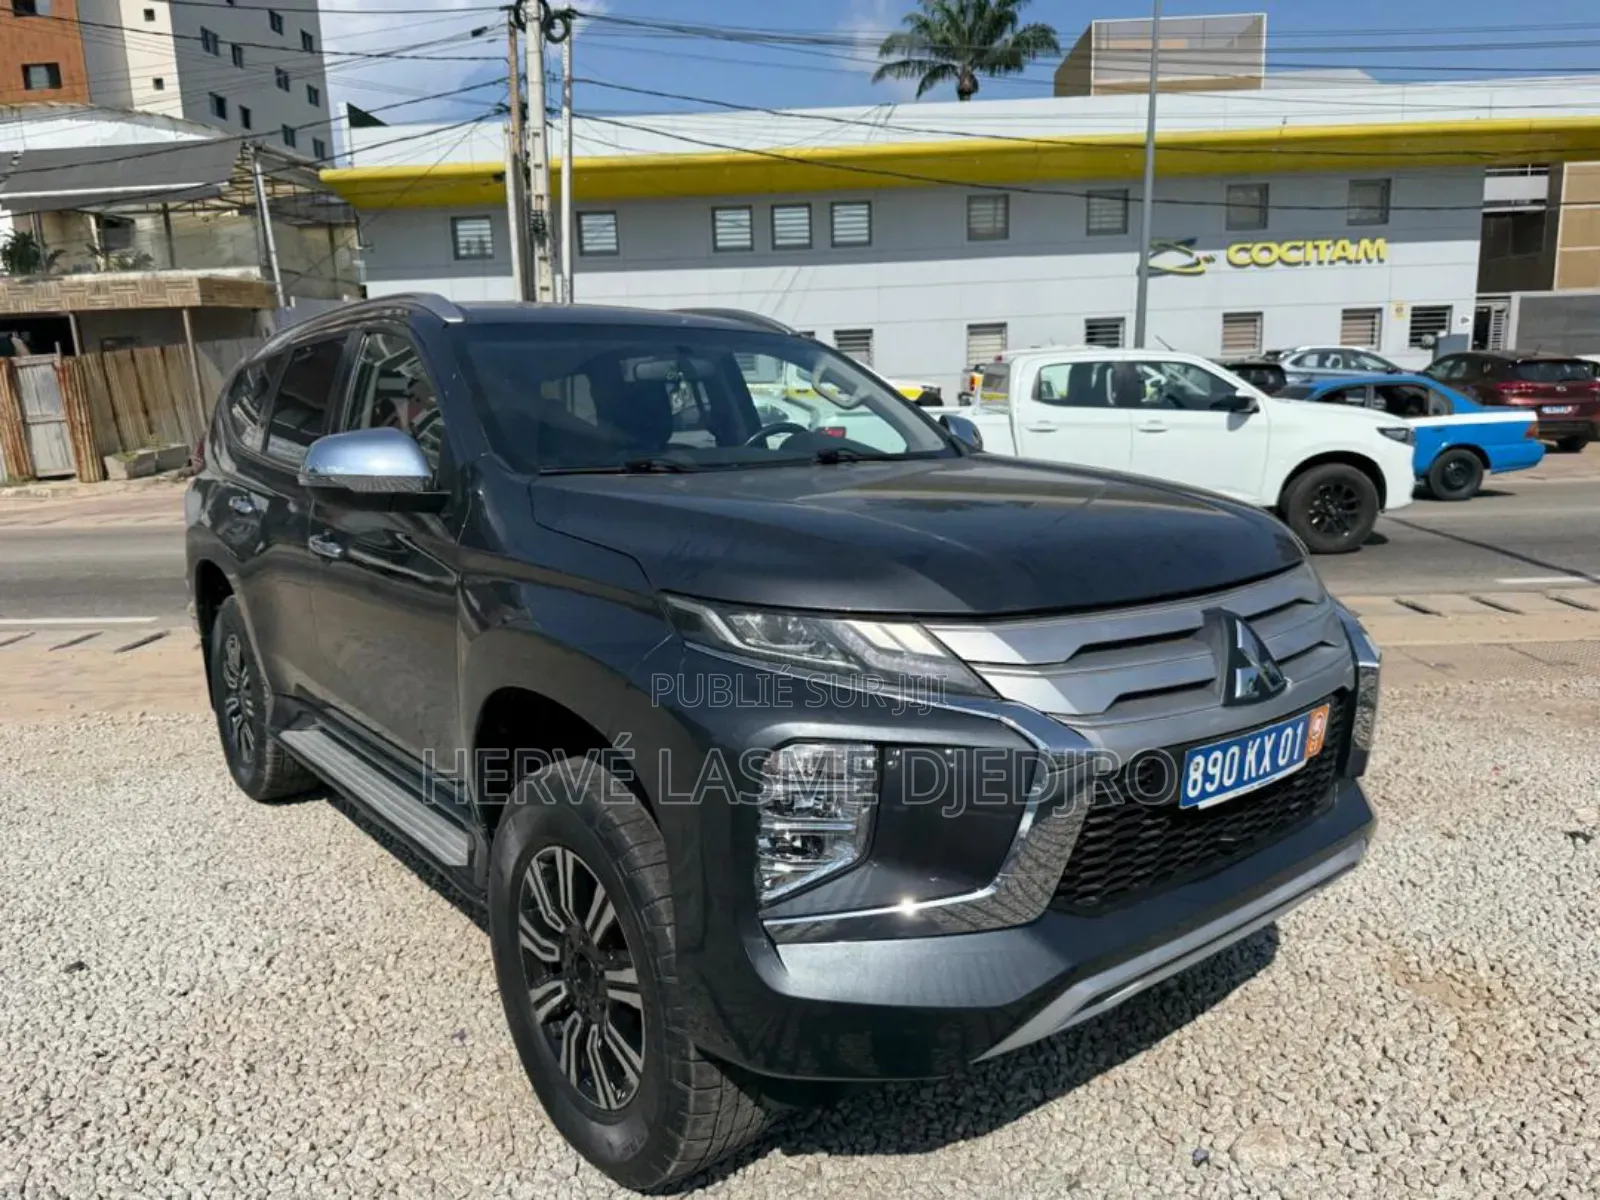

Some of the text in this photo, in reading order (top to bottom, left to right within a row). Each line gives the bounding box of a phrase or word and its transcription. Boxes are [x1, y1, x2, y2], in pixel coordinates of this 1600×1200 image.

[1226, 237, 1388, 268] COCITAM
[1186, 720, 1305, 798] 890 KX 01
